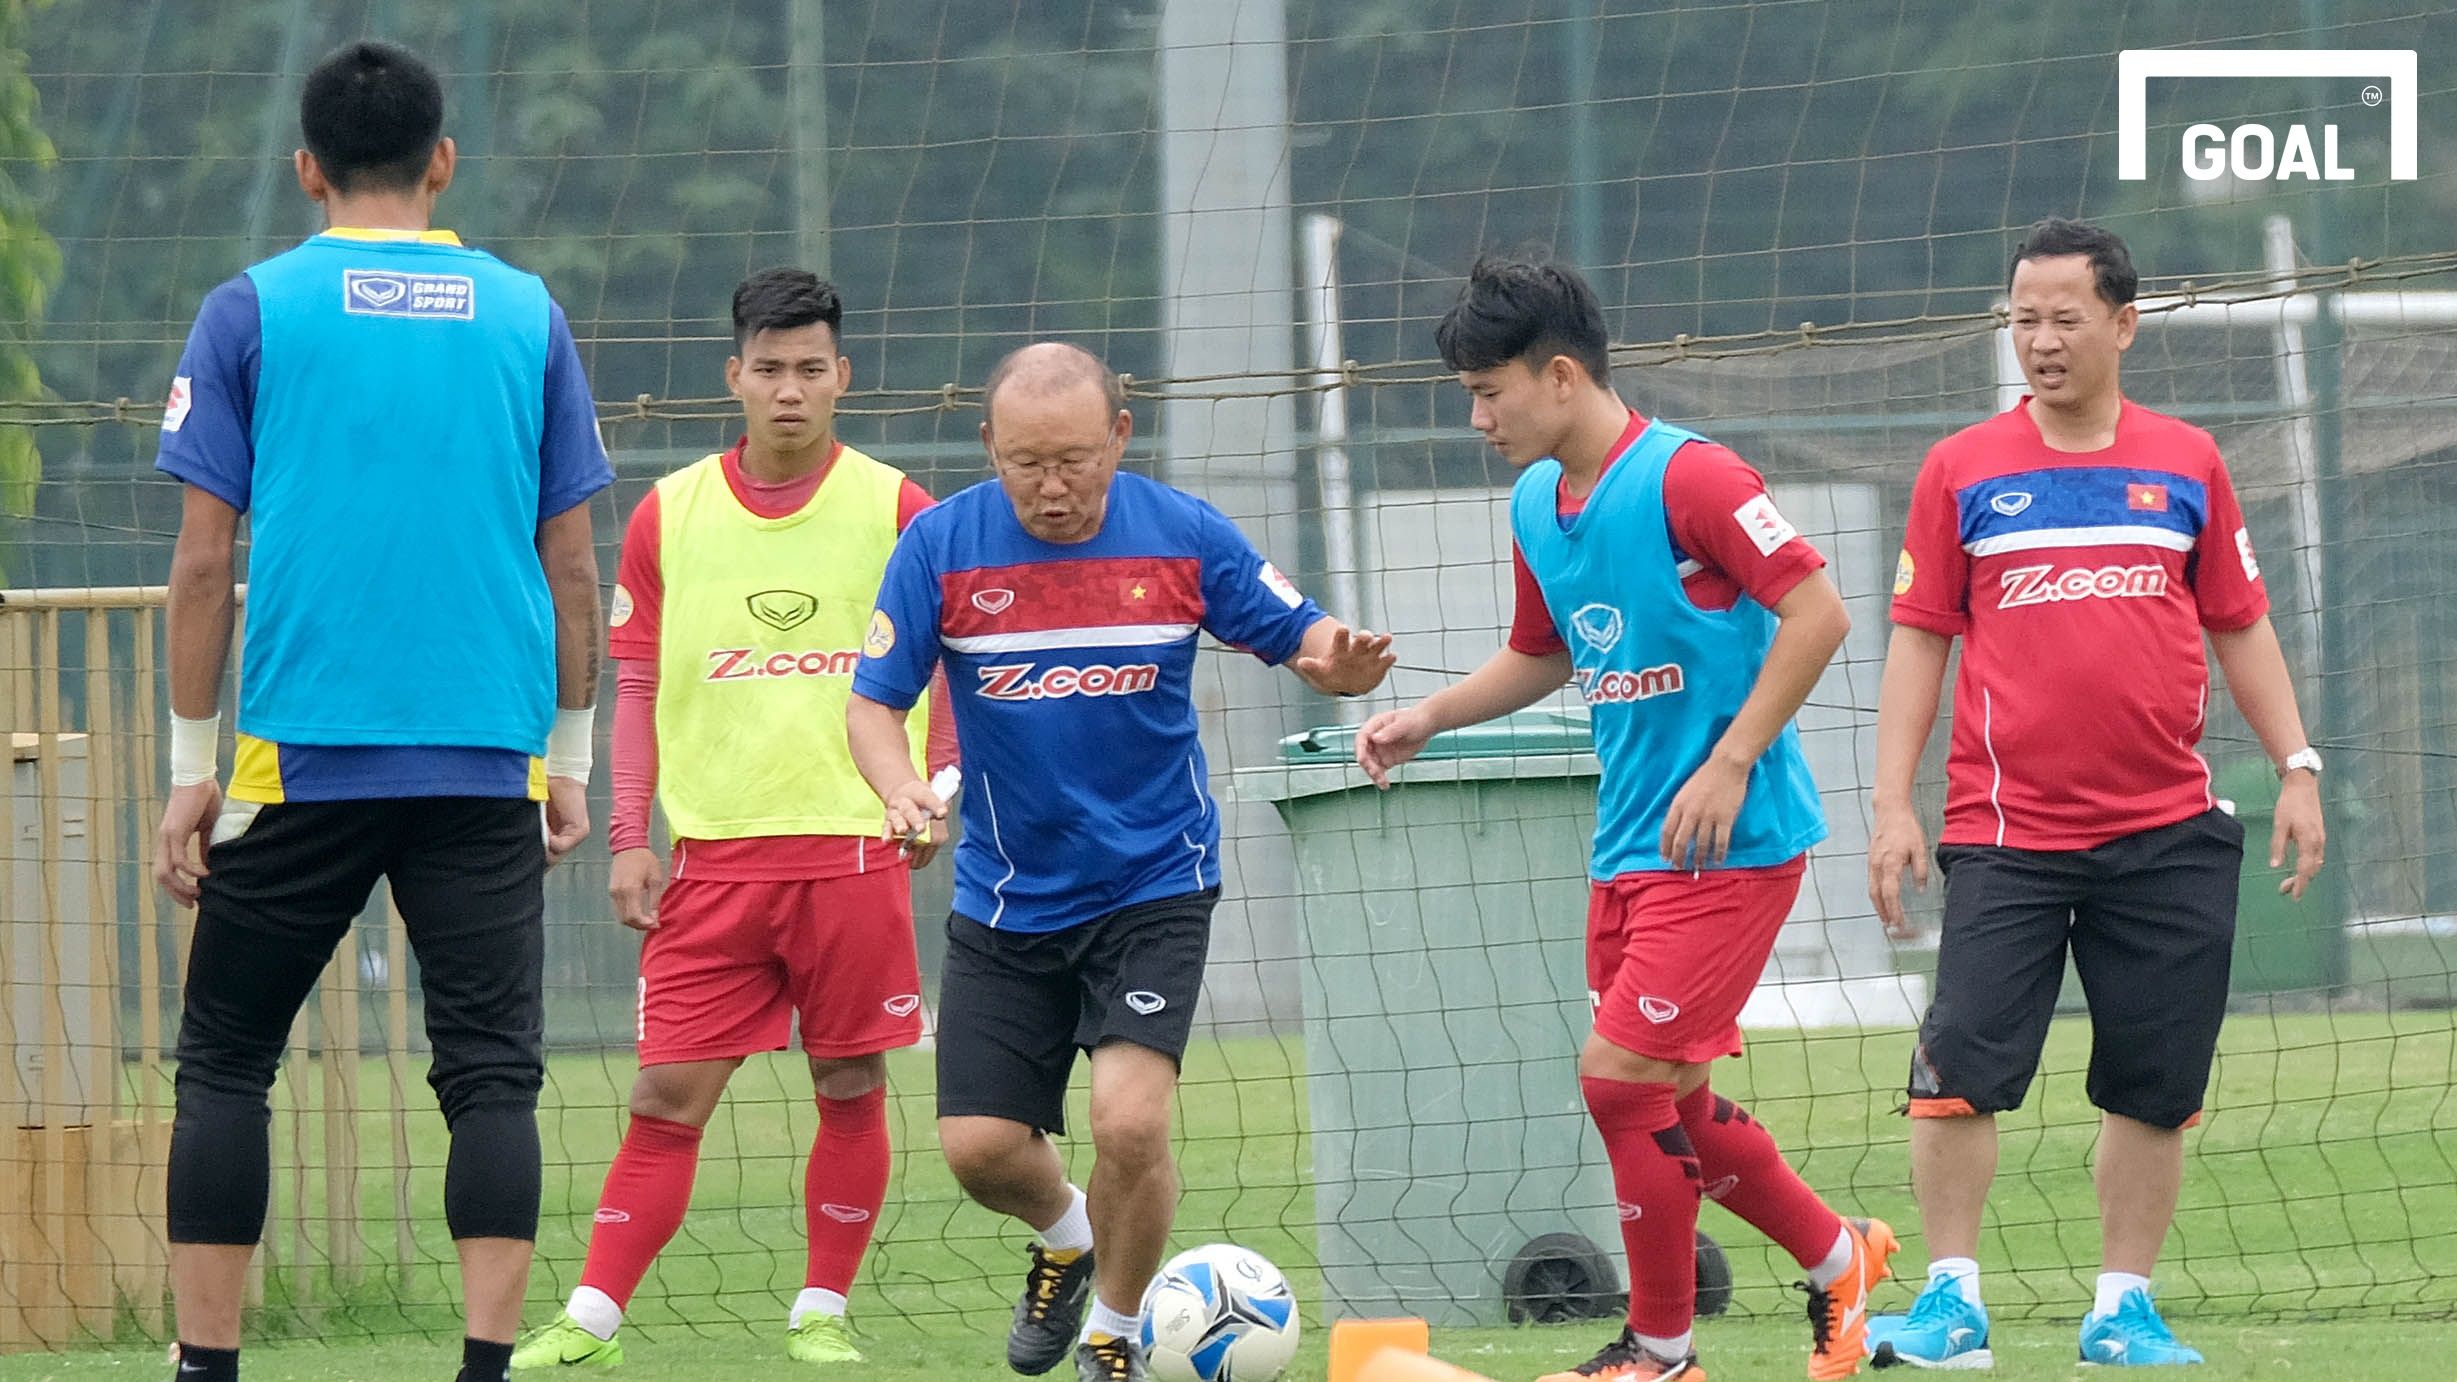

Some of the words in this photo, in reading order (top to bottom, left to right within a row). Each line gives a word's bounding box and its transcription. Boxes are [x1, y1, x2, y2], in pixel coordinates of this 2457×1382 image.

[412, 282, 468, 295] GRAND
[412, 296, 467, 310] SPORT
[1997, 564, 2168, 609] Z.com
[975, 662, 1159, 700] Z.com
